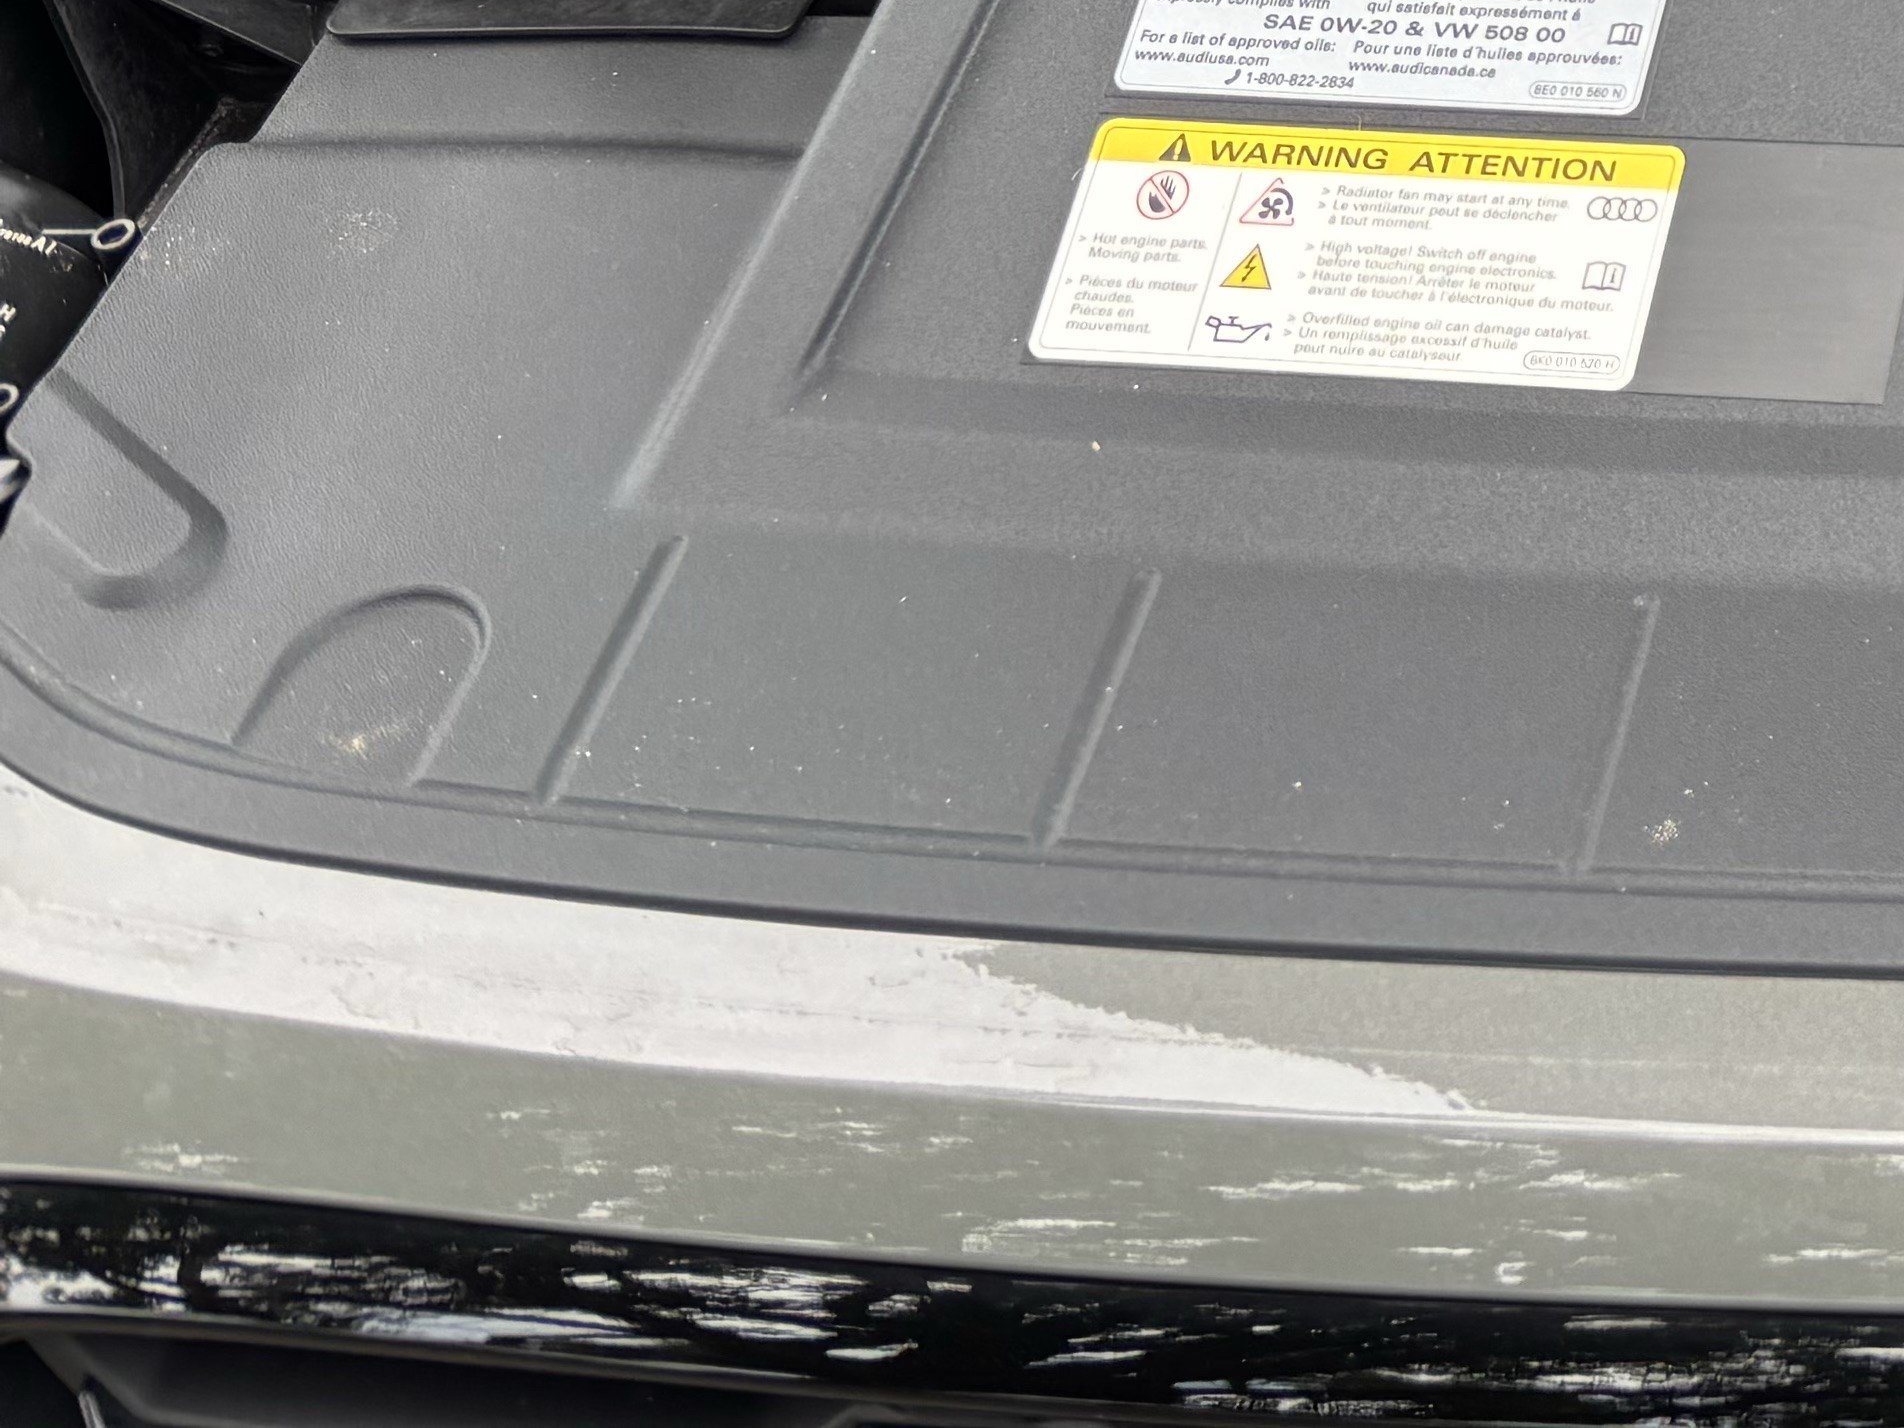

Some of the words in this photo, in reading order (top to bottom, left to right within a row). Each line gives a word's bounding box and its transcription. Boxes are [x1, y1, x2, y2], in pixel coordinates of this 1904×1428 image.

[1366, 0, 1393, 15] qui
[1395, 1, 1456, 16] satisfait
[1459, 6, 1568, 21] expressément
[1263, 13, 1314, 31] SAE
[1320, 17, 1398, 36] 0W-20
[1404, 20, 1425, 37] &
[1434, 21, 1479, 40] VW
[1484, 25, 1529, 42] 508
[1535, 26, 1566, 43] 00
[1140, 29, 1166, 43] For
[1168, 33, 1178, 44] a
[1181, 31, 1206, 46] list
[1208, 32, 1227, 46] of
[1227, 36, 1302, 50] approved
[1304, 38, 1337, 52] oils:
[1353, 39, 1390, 55] Pour
[1393, 45, 1422, 57] une
[1426, 43, 1458, 58] liste
[1135, 50, 1270, 67] www.audiusa.com
[1348, 61, 1497, 79] www.audicanada.ca
[1247, 71, 1355, 89] 1-800-822-2834
[1560, 85, 1583, 98] 010
[1612, 88, 1622, 99] N
[1211, 140, 1389, 170] WARNING
[1408, 151, 1617, 182] ATTENTION
[1336, 184, 1393, 199] Radiator
[1398, 188, 1420, 200] fan
[1423, 192, 1453, 205] may
[1456, 193, 1488, 204] start
[1491, 195, 1505, 205] at
[1508, 196, 1533, 209] any
[1332, 199, 1349, 211] Le
[1353, 202, 1425, 215] ventilateur
[1428, 206, 1460, 218] peut
[1463, 208, 1479, 218] se
[1340, 215, 1368, 227] tout
[1092, 232, 1117, 245] Hot
[1120, 236, 1167, 249] engine
[1088, 246, 1140, 264] Moving
[1320, 240, 1353, 257] High
[1416, 245, 1463, 260] Switch
[1466, 248, 1487, 261] off
[1488, 252, 1537, 266] engine
[1316, 254, 1361, 269] before
[1364, 259, 1425, 275] touching
[1428, 263, 1476, 277] engine
[1126, 277, 1144, 290] du
[1147, 280, 1198, 292] moteur
[1312, 269, 1353, 283] Haute
[1468, 278, 1481, 290] le
[1485, 281, 1535, 293] moteur
[1307, 285, 1347, 296] avant
[1349, 286, 1368, 298] de
[1371, 287, 1424, 301] toucher
[1538, 296, 1557, 309] du
[1116, 308, 1135, 318] en
[1302, 311, 1370, 327] Overfilled
[1373, 318, 1421, 332] engine
[1424, 319, 1443, 331] oil
[1445, 322, 1470, 332] can
[1473, 322, 1531, 338] damage
[1293, 343, 1326, 355] peut
[1329, 344, 1365, 356] nuire
[1368, 347, 1386, 358] au
